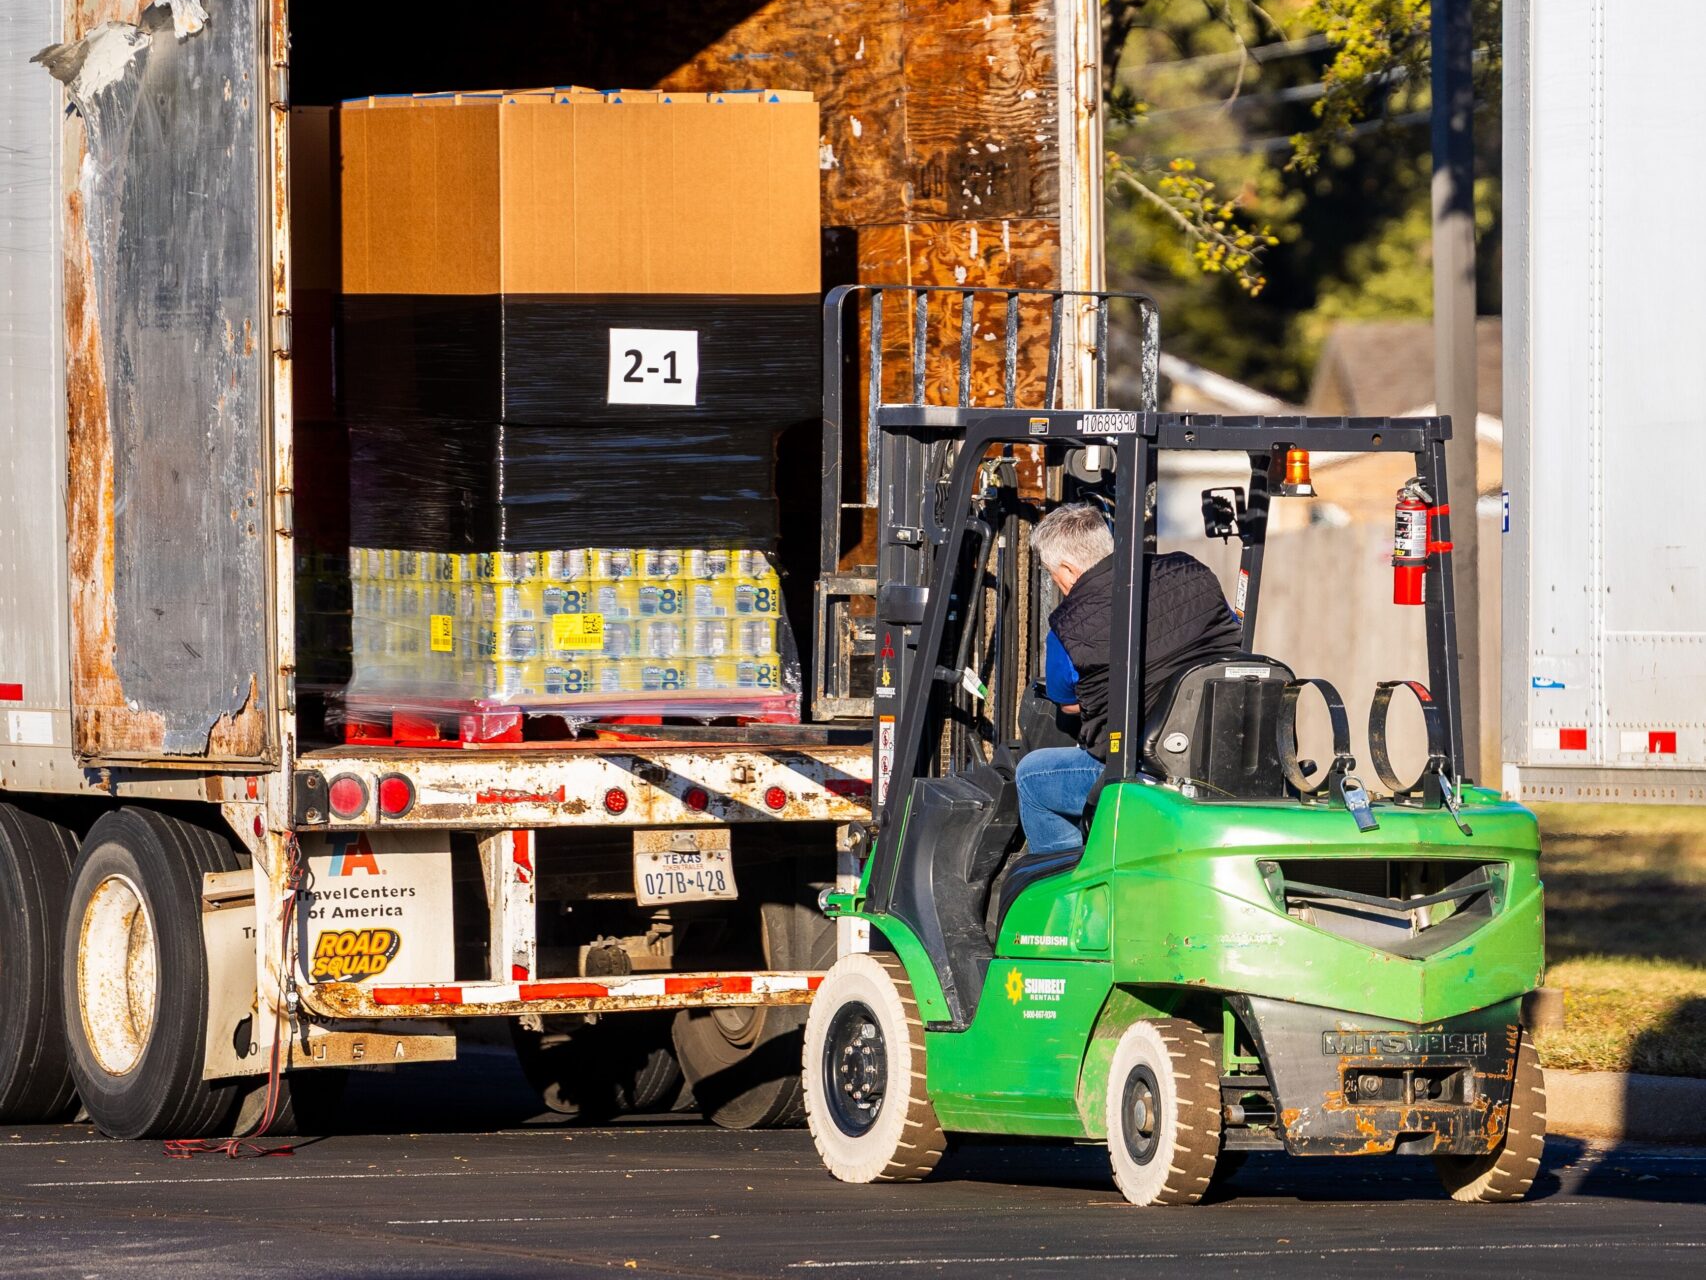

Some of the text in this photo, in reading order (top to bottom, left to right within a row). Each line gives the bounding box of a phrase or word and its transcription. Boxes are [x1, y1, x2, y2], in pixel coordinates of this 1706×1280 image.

[623, 349, 682, 384] 2-1
[1085, 414, 1136, 432] 10689390
[658, 588, 677, 615] 8
[754, 587, 771, 612] 8
[564, 669, 582, 694] 8
[756, 663, 771, 688] 8
[325, 831, 380, 877] TA
[664, 854, 702, 864] TEXAS
[296, 887, 416, 902] TravelCenters
[645, 870, 726, 895] 027B 428
[308, 904, 403, 919] of America
[315, 930, 392, 957] ROAD
[1020, 934, 1068, 946] MITSUBISHI
[312, 955, 388, 979] SQUAD
[1024, 978, 1066, 995] SUNBELT
[1325, 1033, 1487, 1054] MITSUBISHI
